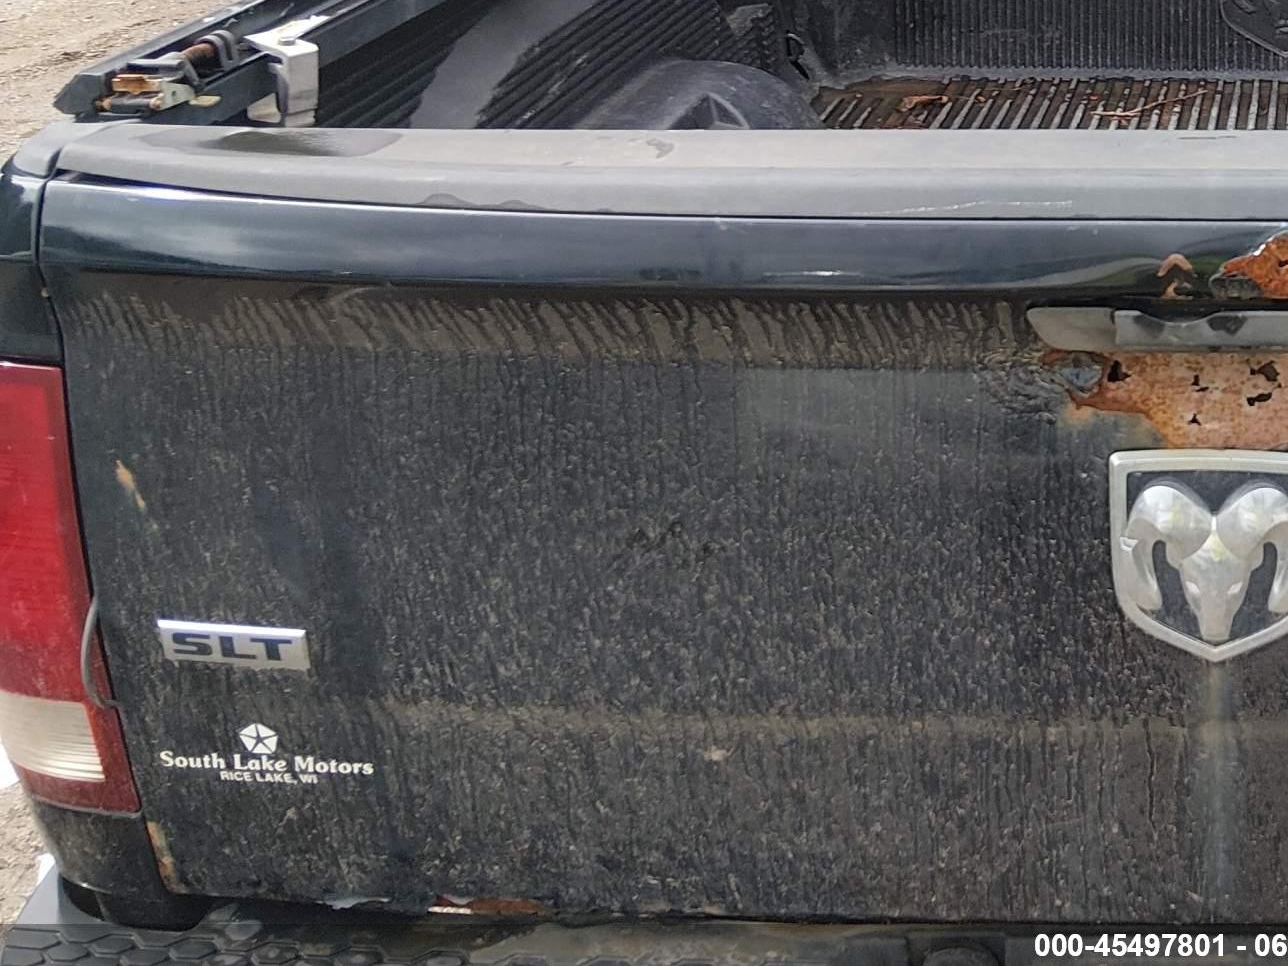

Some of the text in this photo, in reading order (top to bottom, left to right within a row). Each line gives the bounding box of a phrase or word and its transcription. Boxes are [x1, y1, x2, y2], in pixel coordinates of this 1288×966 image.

[172, 632, 292, 661] SLT
[159, 750, 375, 775] South Lake Motors
[220, 770, 252, 782] RICE
[299, 774, 318, 784] WI
